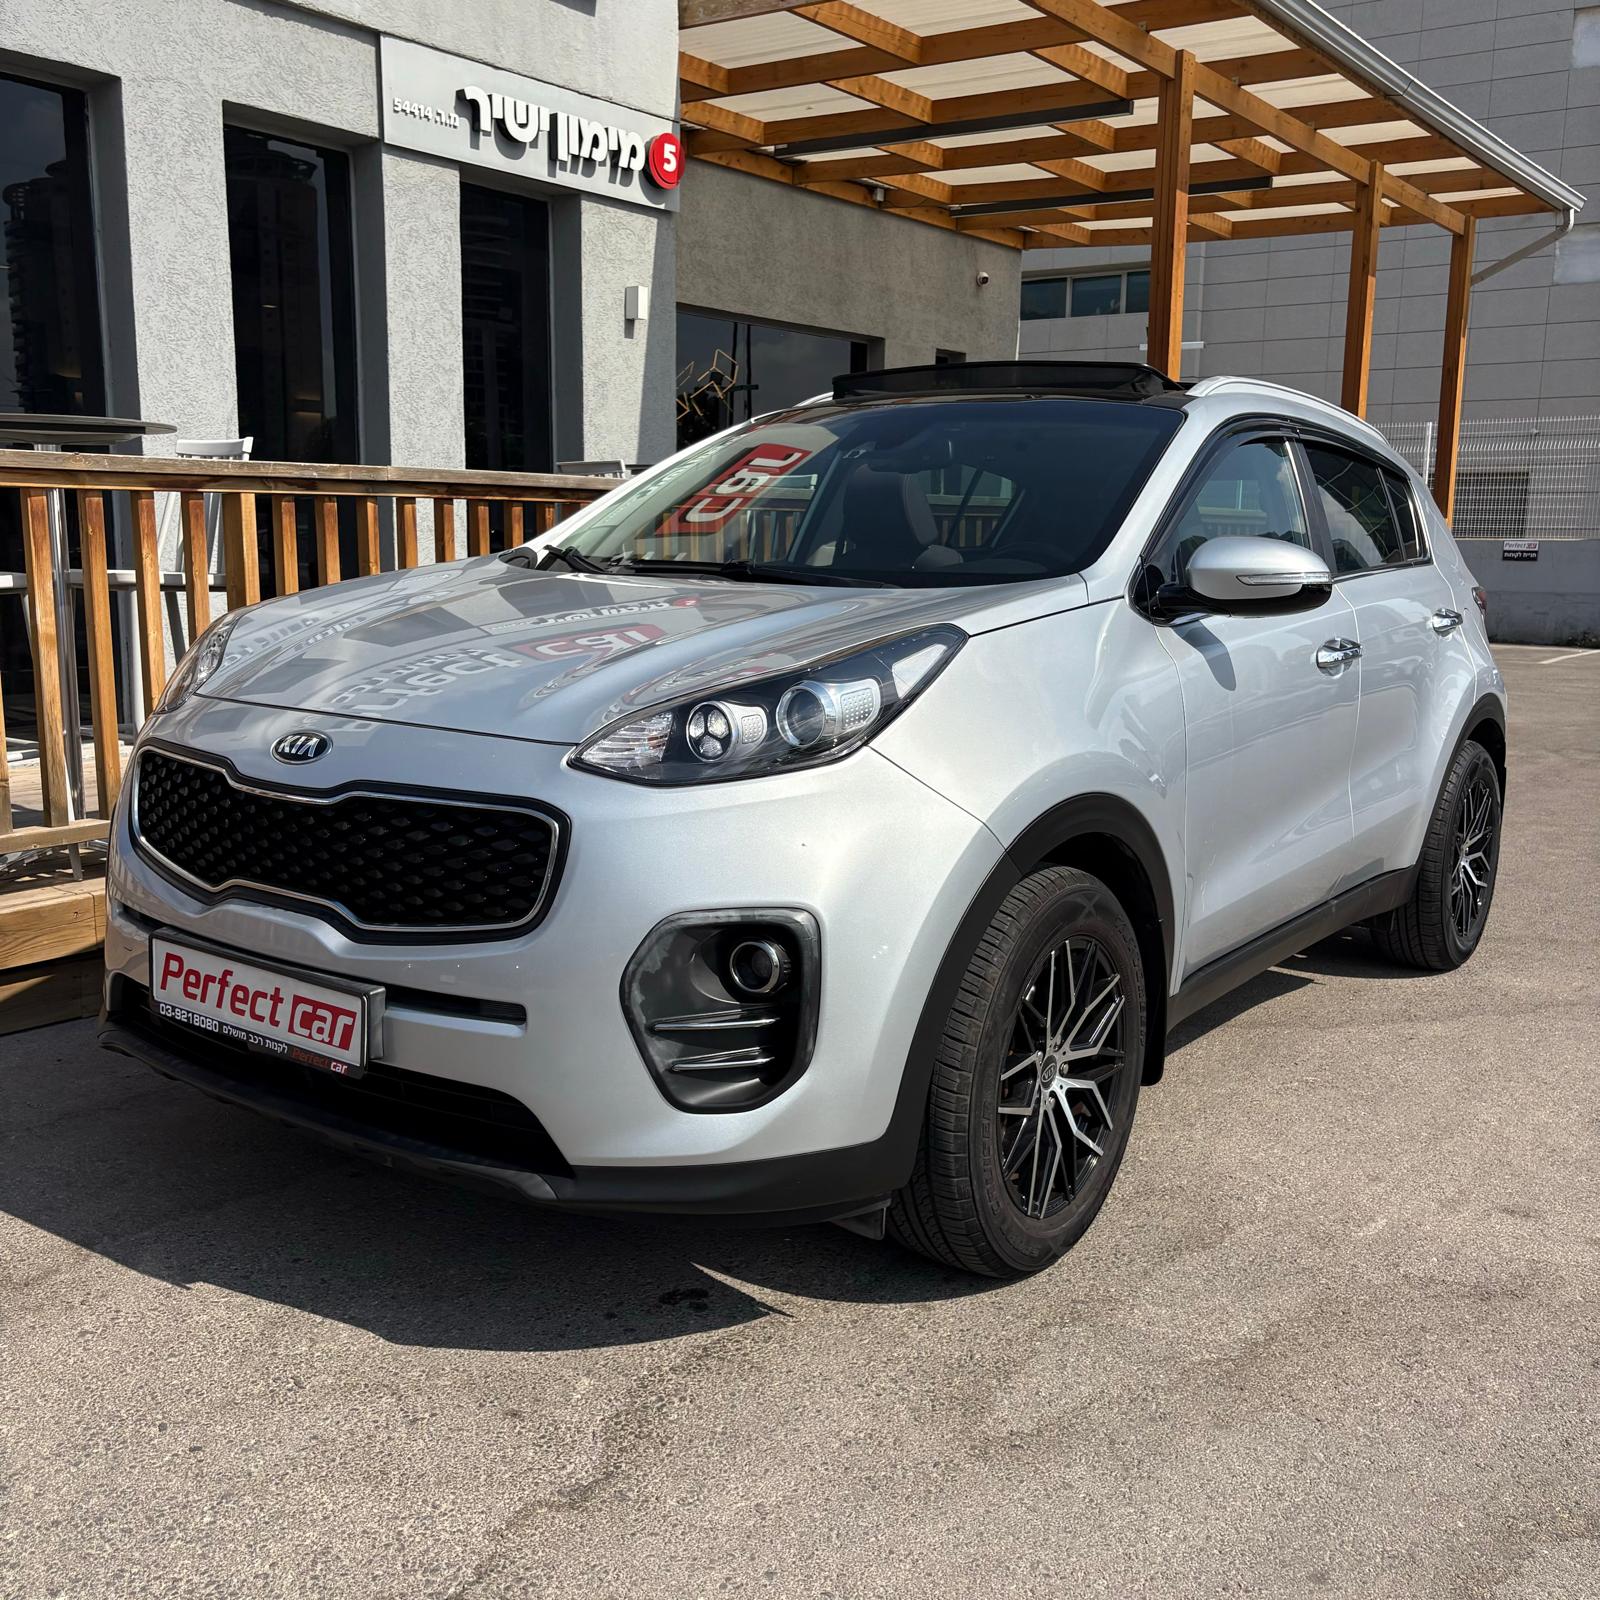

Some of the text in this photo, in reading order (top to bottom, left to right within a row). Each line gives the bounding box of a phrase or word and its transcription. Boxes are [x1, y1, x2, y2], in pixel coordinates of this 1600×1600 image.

[393, 96, 433, 120] 54414
[461, 86, 646, 171] מימון ישיר
[662, 144, 678, 173] 5
[277, 735, 321, 758] KIA
[160, 952, 354, 1047] Perfect car
[159, 1003, 219, 1033] 03-9218080
[222, 1025, 288, 1054] לקנות רכב מושלם
[330, 1061, 348, 1074] car
